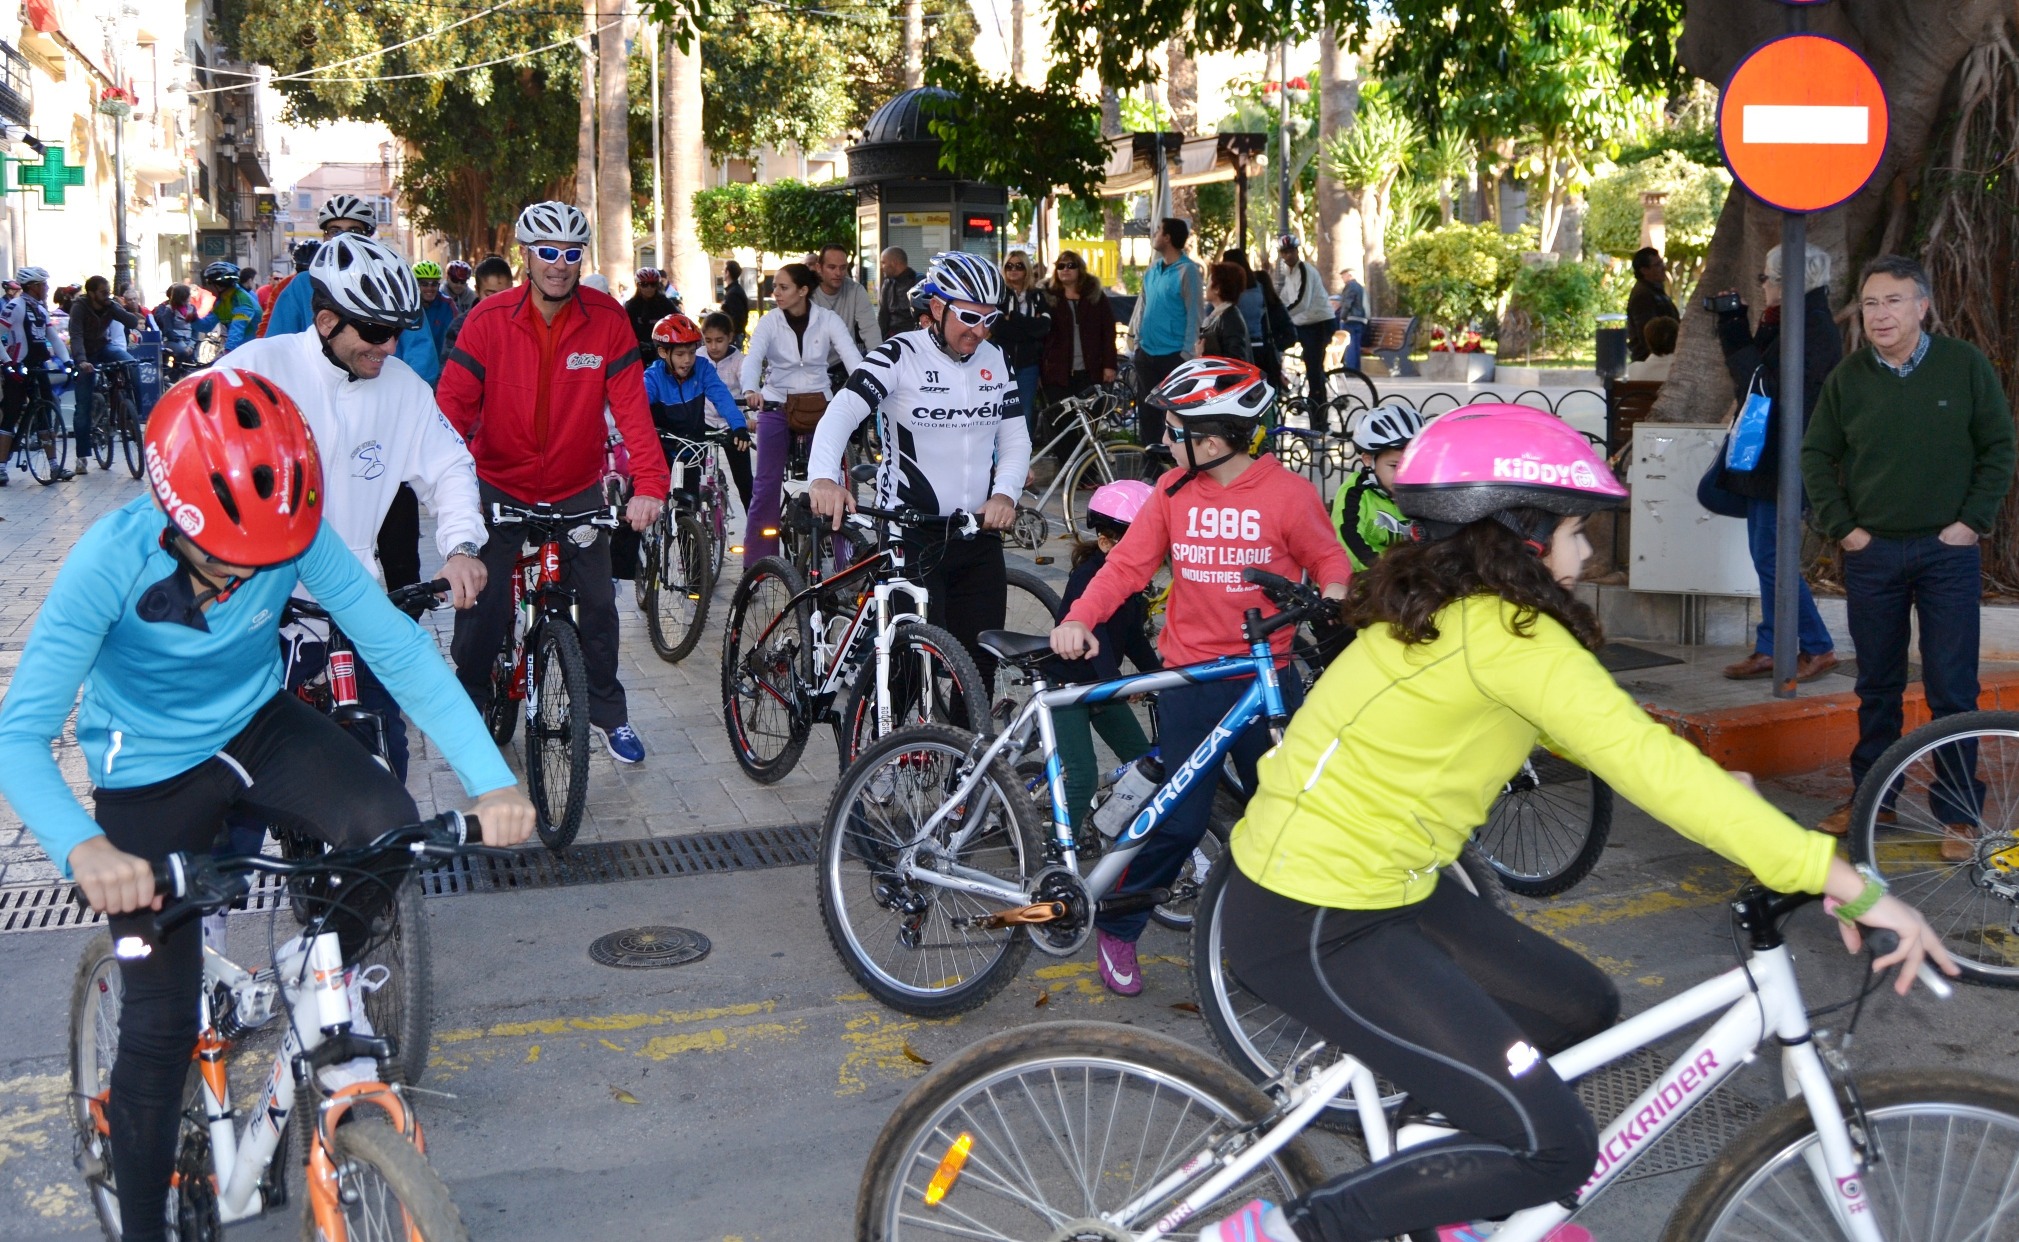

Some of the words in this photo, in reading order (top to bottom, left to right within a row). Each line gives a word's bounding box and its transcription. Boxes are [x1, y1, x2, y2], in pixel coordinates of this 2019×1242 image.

[863, 378, 884, 401] ROTO
[925, 371, 940, 384] 3T
[1493, 457, 1570, 485] KiDDY
[1186, 507, 1261, 541] 1986
[1172, 542, 1216, 565] SPORT
[1219, 546, 1273, 566] LEAGUE
[1181, 567, 1241, 584] INDUSTRIES
[833, 605, 876, 683] TREK
[526, 653, 534, 695] DEUCE
[1128, 725, 1233, 840] ORBEA
[1576, 1048, 1720, 1196] OCKRIDER
